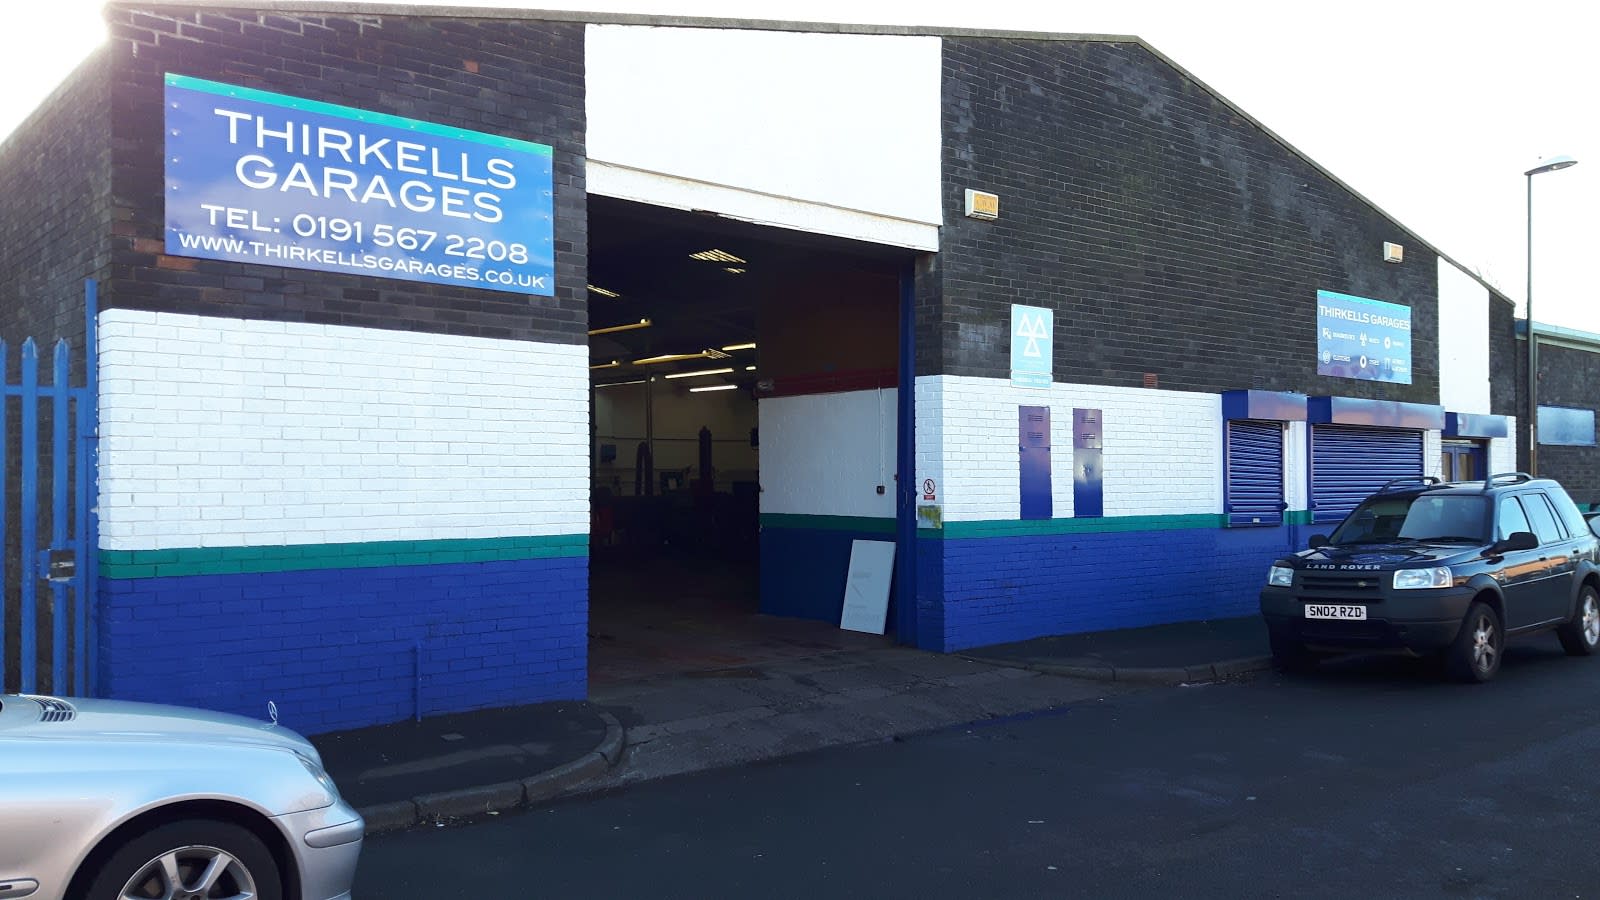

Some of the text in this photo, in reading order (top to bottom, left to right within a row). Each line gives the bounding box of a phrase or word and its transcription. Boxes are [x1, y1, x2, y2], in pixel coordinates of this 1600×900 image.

[213, 108, 517, 190] THIRKELLS
[235, 154, 504, 223] GARAGES
[178, 233, 545, 289] WWW.THIRKELLSGARAGES.CO.UK
[200, 203, 529, 265] TEL: 0191 567 2208
[1319, 305, 1410, 330] THIRKELLS GARAGES
[1309, 606, 1362, 618] SN02 RZD
